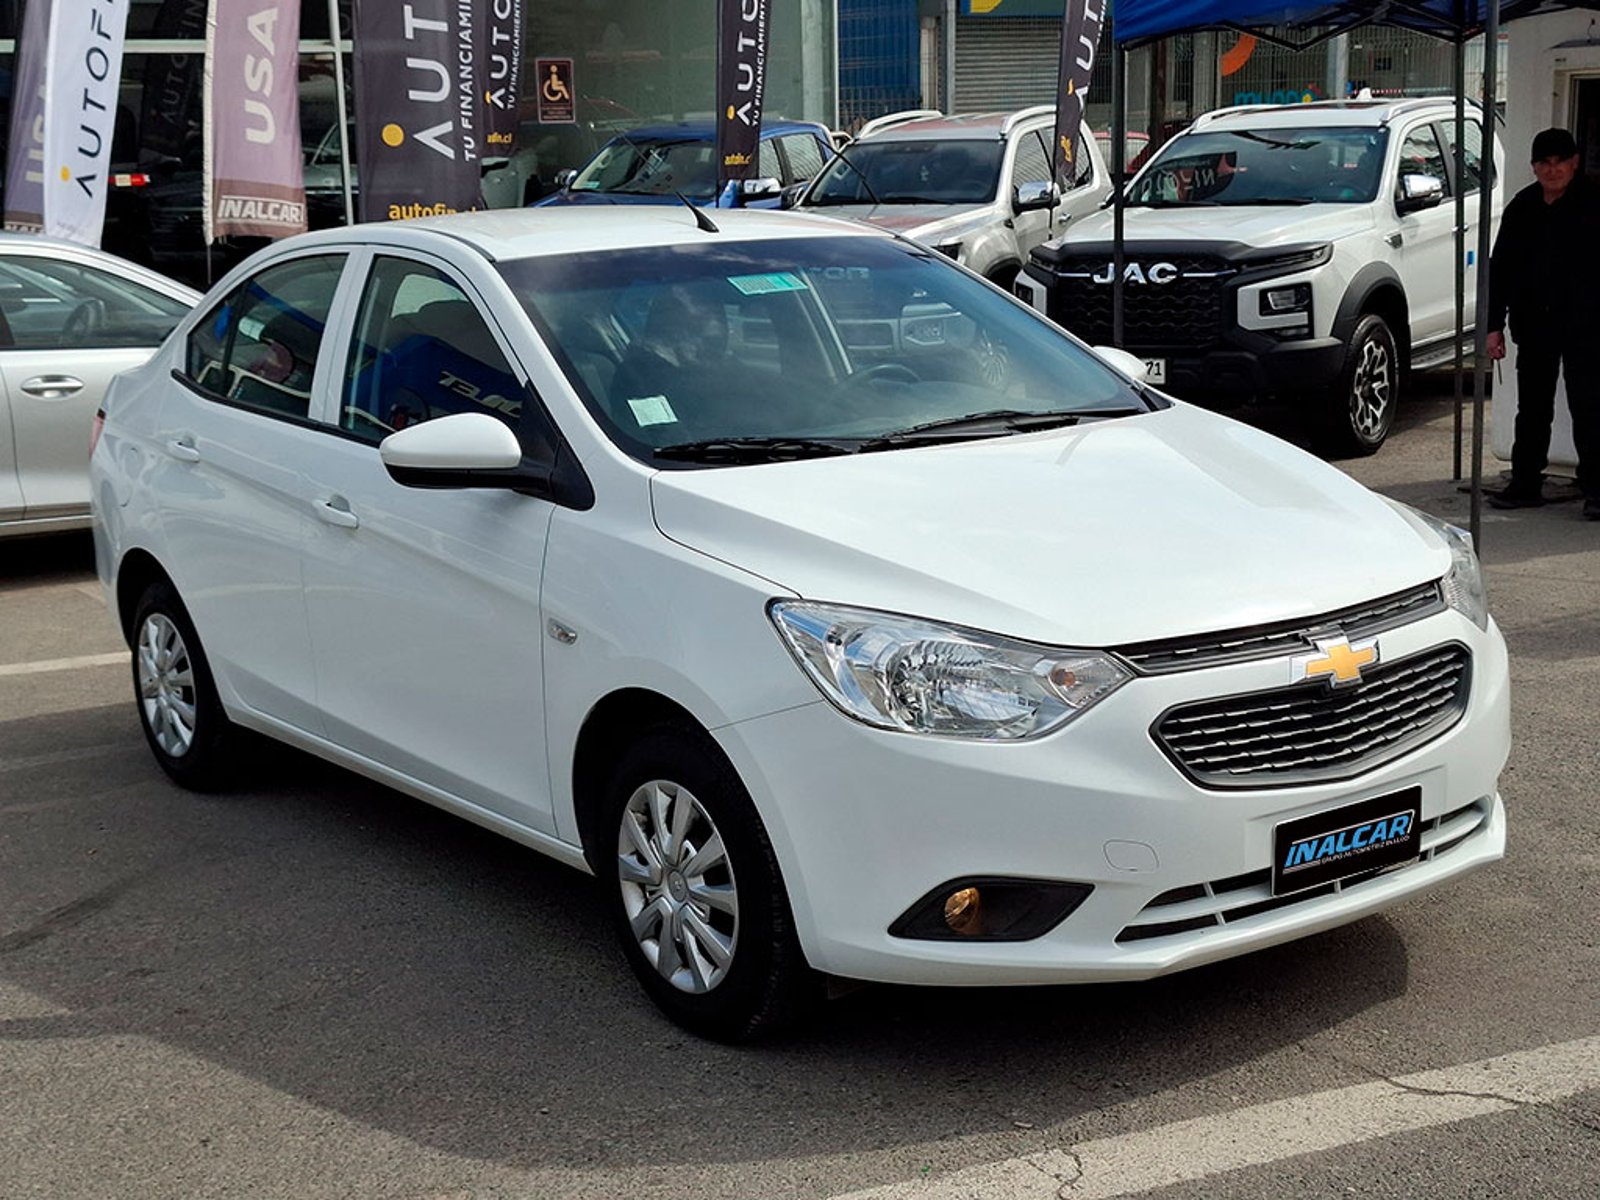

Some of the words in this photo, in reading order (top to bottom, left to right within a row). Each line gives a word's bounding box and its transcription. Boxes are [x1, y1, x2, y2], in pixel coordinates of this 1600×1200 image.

[244, 7, 279, 145] USA
[404, 4, 455, 160] AUT
[458, 0, 475, 130] FINANCIAMI
[75, 0, 114, 198] AUTOF
[507, 95, 516, 109] TU
[752, 111, 761, 126] TU
[465, 136, 477, 162] TU
[218, 199, 303, 223] INALCAR
[1093, 262, 1177, 285] JAC
[1284, 816, 1410, 867] INALCAR
